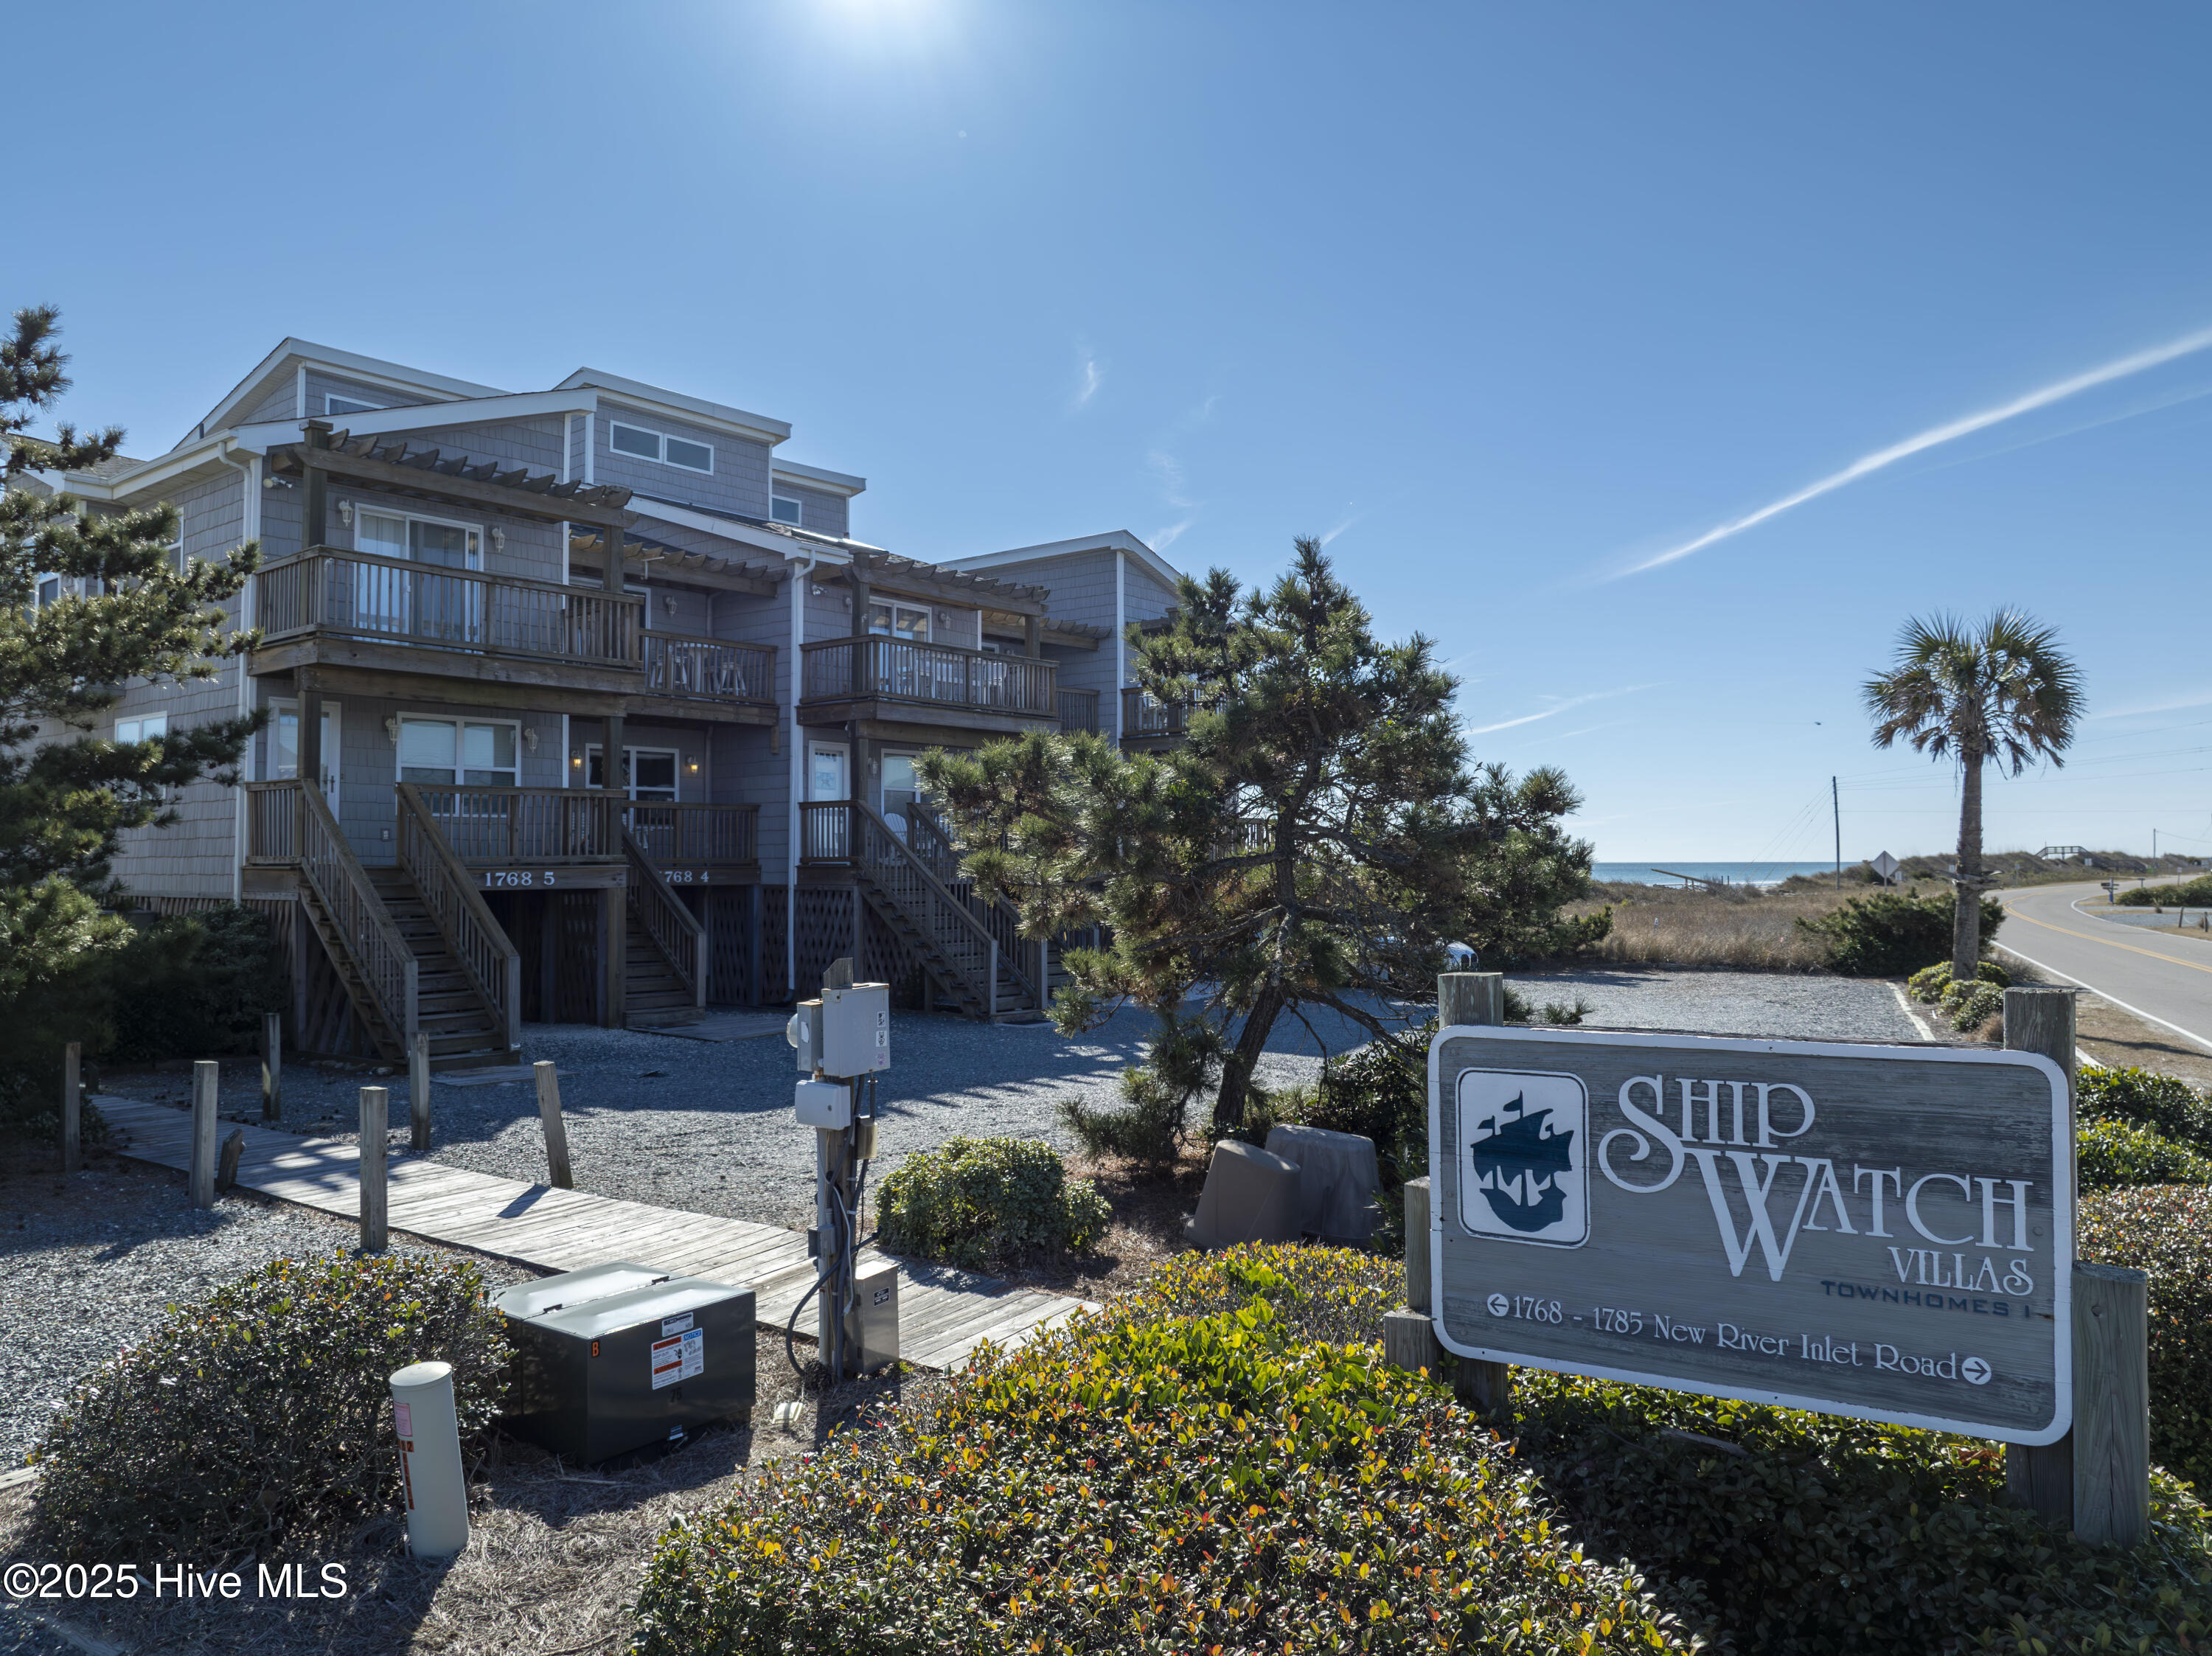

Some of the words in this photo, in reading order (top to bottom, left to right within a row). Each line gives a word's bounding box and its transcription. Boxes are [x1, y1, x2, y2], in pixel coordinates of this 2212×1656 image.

[485, 872, 532, 886] 1768
[543, 872, 554, 886] 5
[658, 870, 693, 883] 768
[700, 870, 709, 883] 4
[1598, 1074, 1815, 1193] SHIP
[1683, 1147, 2034, 1282] WATCH
[1887, 1246, 2034, 1296] VILLAS
[1820, 1280, 2009, 1317] TOWNHOMES
[592, 1341, 599, 1357] B
[684, 1330, 702, 1340] NOTICE
[1513, 1295, 1563, 1323] 1768
[1593, 1307, 1644, 1335] 1785
[1653, 1314, 1706, 1344] New
[1717, 1323, 1790, 1356] River
[1799, 1333, 1863, 1366] Inlet
[1874, 1343, 1958, 1380] Road
